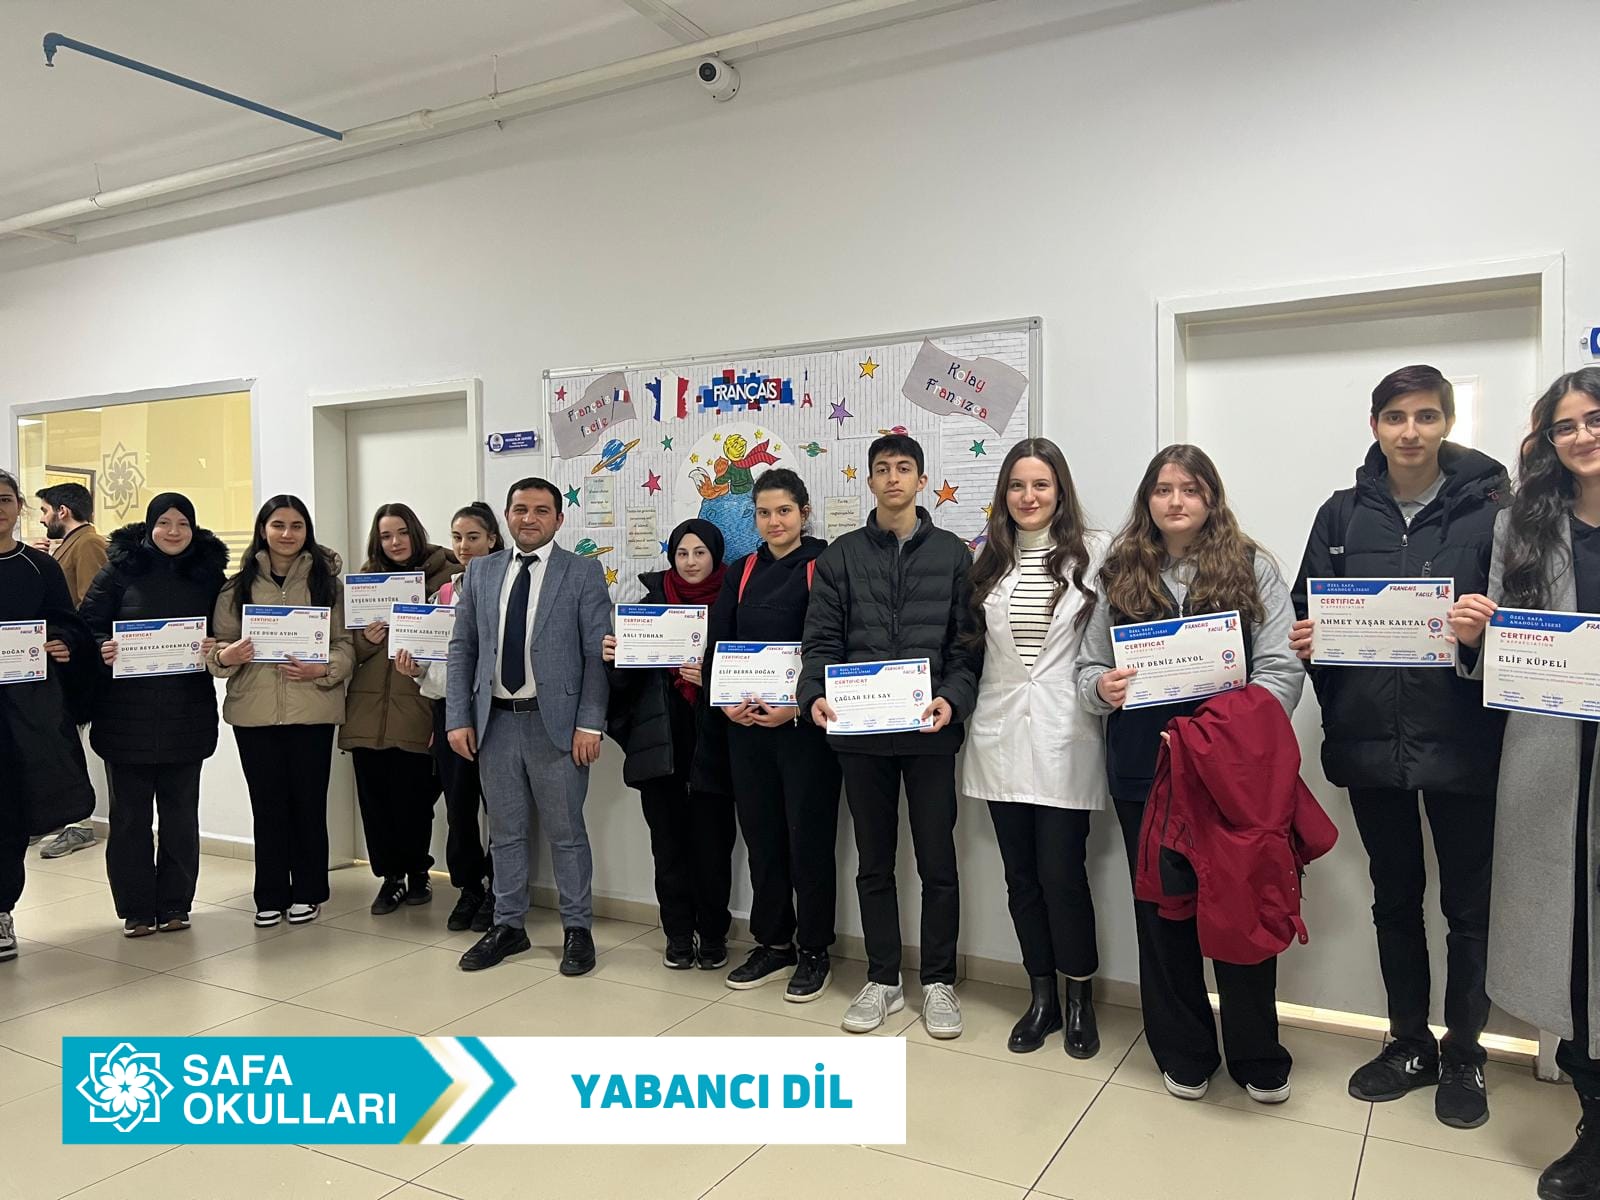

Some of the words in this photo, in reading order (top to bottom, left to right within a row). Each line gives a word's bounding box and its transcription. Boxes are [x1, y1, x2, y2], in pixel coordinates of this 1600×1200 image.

[947, 361, 986, 393] Kolay
[713, 381, 778, 403] FRANÇAIS
[1354, 619, 1386, 627] YAŞAR
[1500, 631, 1556, 642] CERTIFICAT
[1124, 640, 1165, 650] CERTIFICAT
[1147, 658, 1174, 668] DENİZ
[1176, 655, 1204, 664] AKYOL
[1498, 655, 1522, 664] ELİF
[1526, 657, 1567, 668] KÜPELİ
